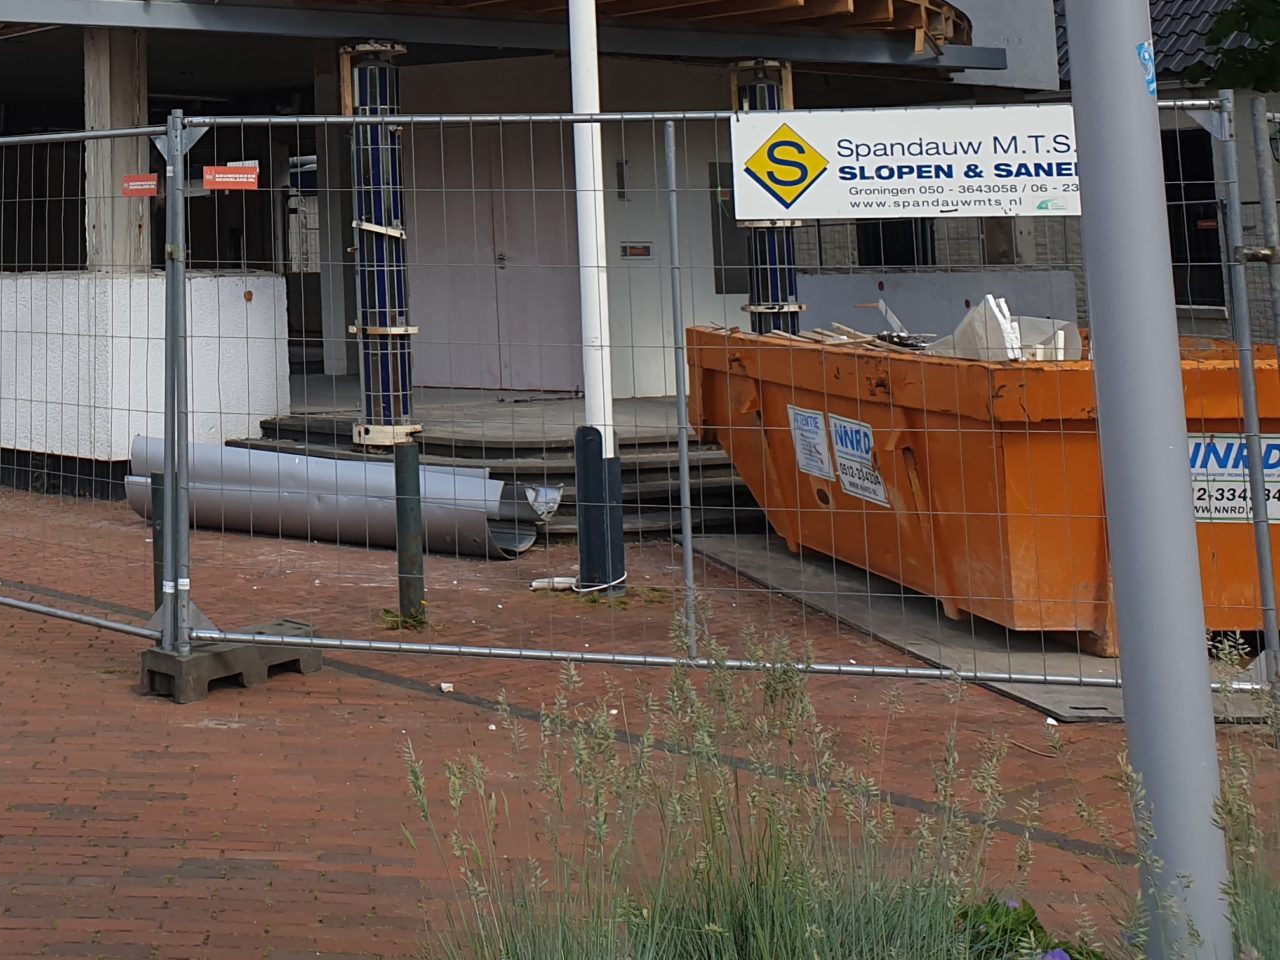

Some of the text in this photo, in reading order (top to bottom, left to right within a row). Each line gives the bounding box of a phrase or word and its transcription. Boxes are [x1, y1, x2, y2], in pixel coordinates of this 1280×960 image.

[837, 137, 982, 162] Spandauw
[838, 162, 1079, 180] SLOPEN & SANE
[849, 186, 915, 197] Groningen
[919, 185, 944, 194] 050
[958, 184, 1018, 194] 3643058
[1031, 184, 1048, 193] 06
[850, 197, 1022, 209] www.spandauwmtsnl
[834, 423, 871, 455] NNRD
